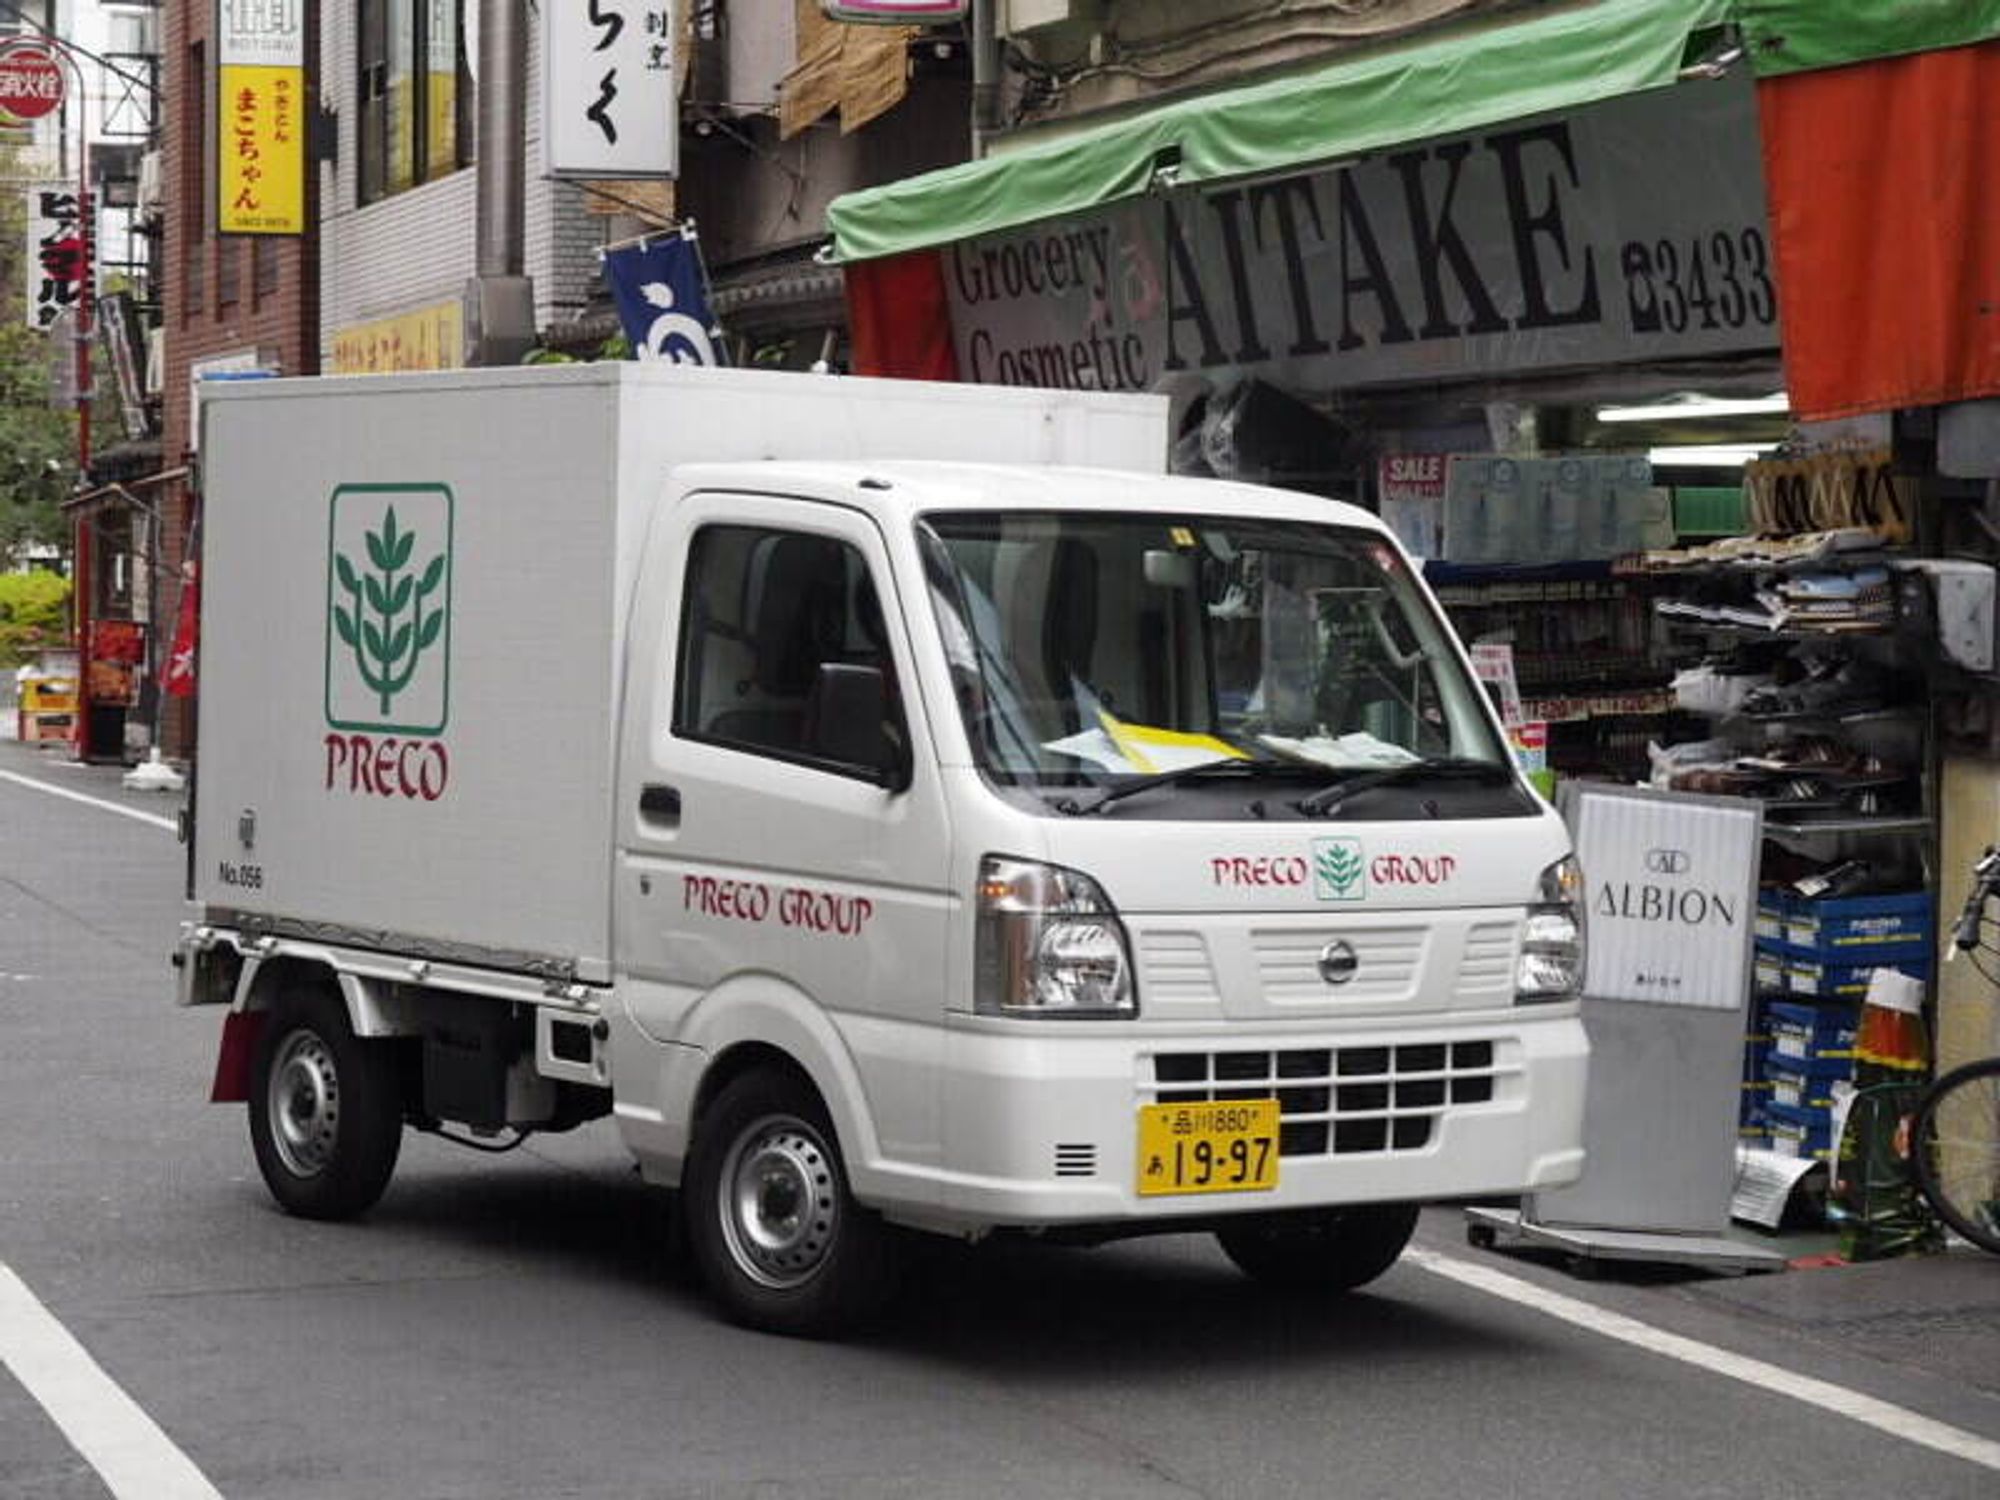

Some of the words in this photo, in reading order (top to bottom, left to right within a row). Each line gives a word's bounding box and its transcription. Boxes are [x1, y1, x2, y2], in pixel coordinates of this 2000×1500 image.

[234, 87, 261, 210] まこちゃん
[952, 225, 1110, 306] Grocery
[1164, 119, 1602, 370] AITAKE
[1655, 226, 1777, 335] 3433
[969, 316, 1149, 392] Cosmetic
[1387, 455, 1441, 481] SALE
[324, 733, 449, 801] PRECO
[1210, 856, 1308, 886] PRECO
[1370, 854, 1455, 885] GROUP
[1597, 880, 1736, 926] ALBION
[683, 875, 770, 922] PRECO
[779, 887, 873, 937] GROUP
